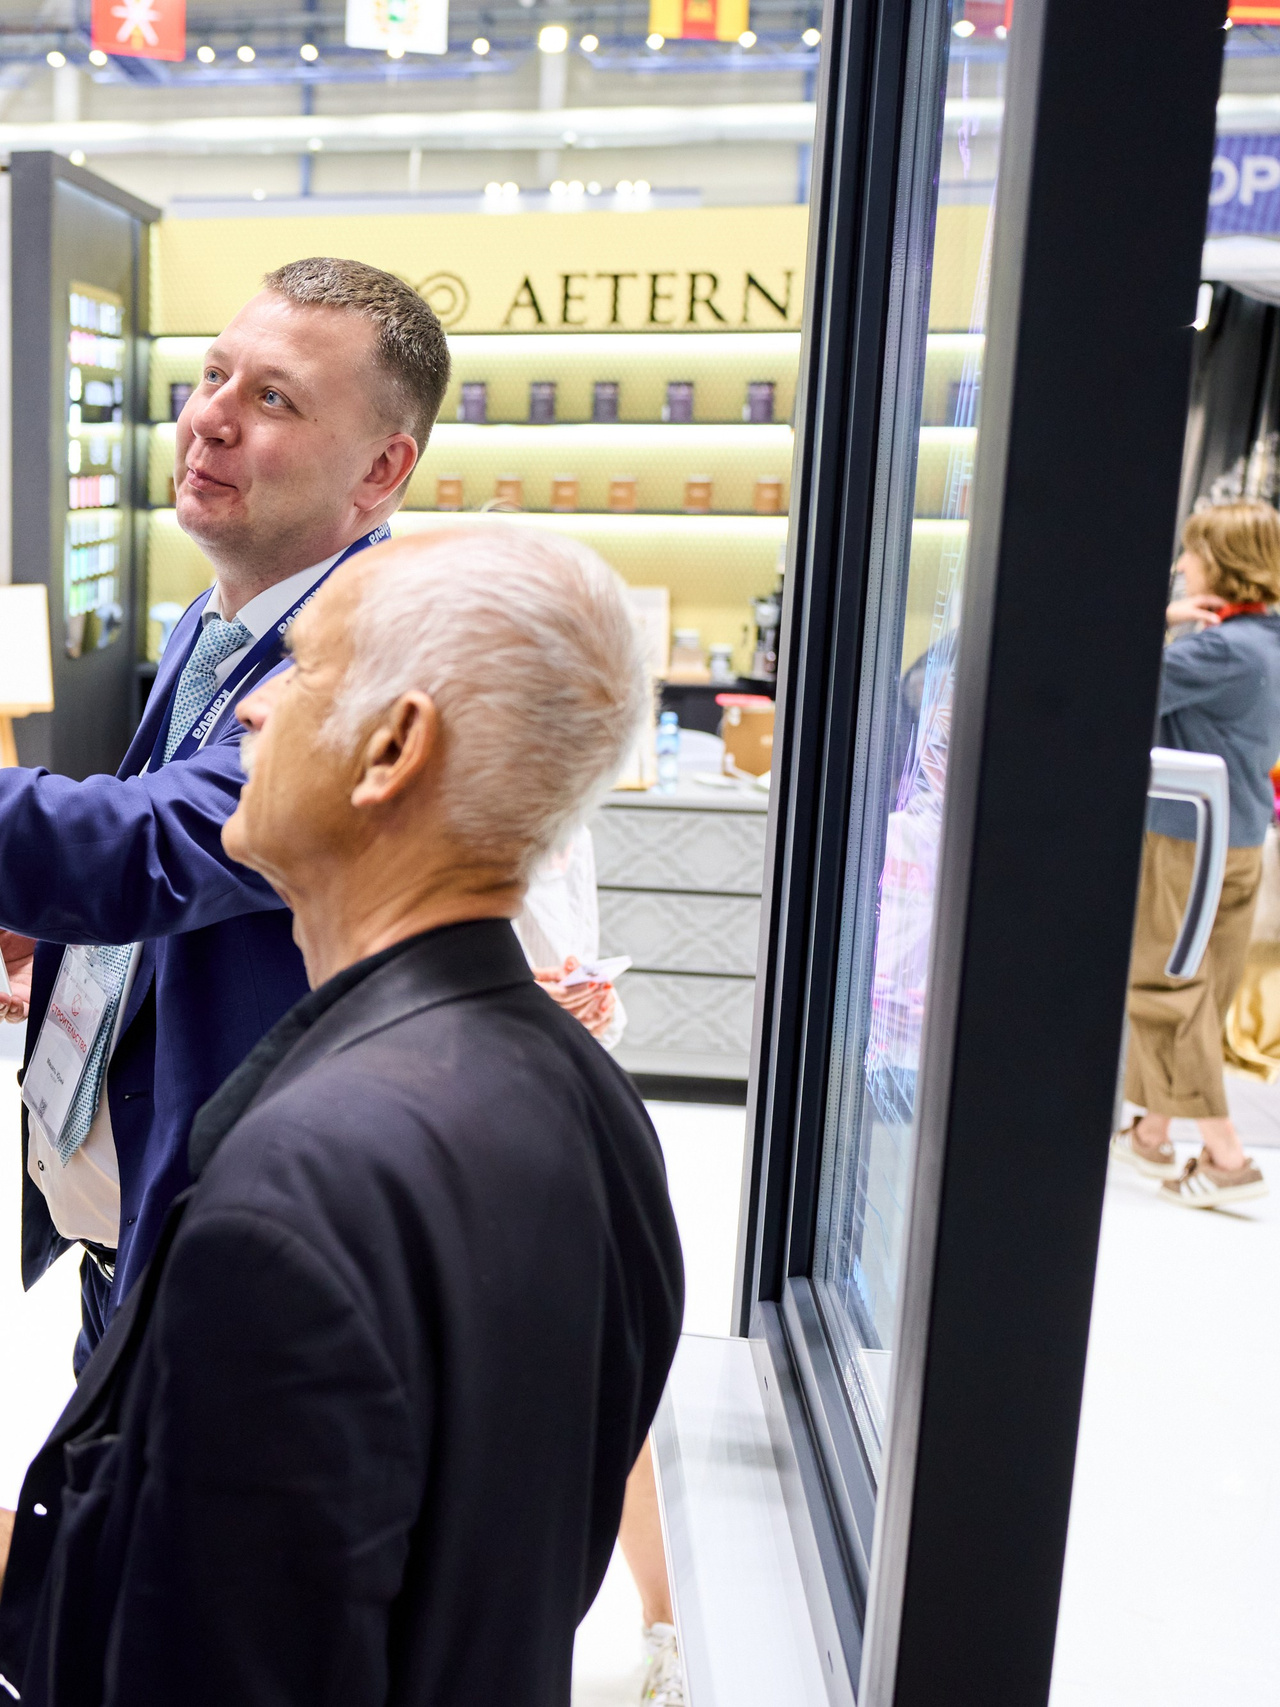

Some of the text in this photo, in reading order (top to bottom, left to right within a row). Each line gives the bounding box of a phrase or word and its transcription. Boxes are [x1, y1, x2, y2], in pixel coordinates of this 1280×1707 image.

[503, 270, 800, 325] AETERN
[192, 688, 230, 740] kaleva
[51, 1003, 87, 1053] СТРОИТЕЛЬСТВО
